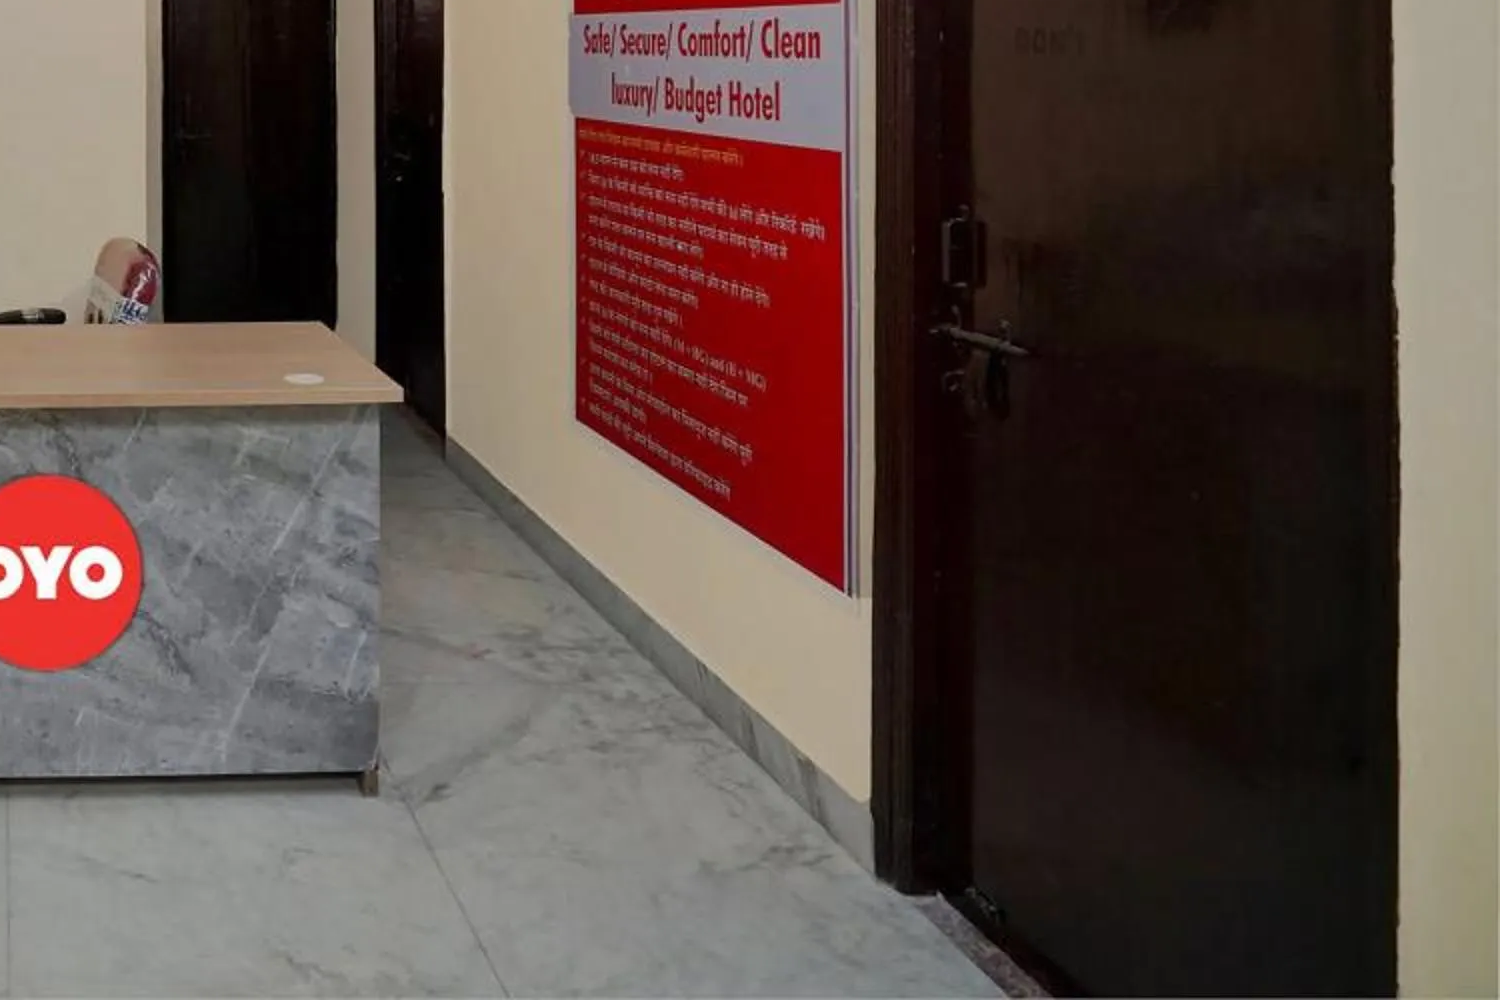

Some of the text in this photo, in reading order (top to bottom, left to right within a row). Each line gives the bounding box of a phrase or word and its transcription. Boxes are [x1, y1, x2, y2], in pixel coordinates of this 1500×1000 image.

[583, 18, 821, 62] Safe/ Secure/ Comfort/ Clean
[665, 75, 722, 124] Budget
[728, 80, 781, 121] Hotel
